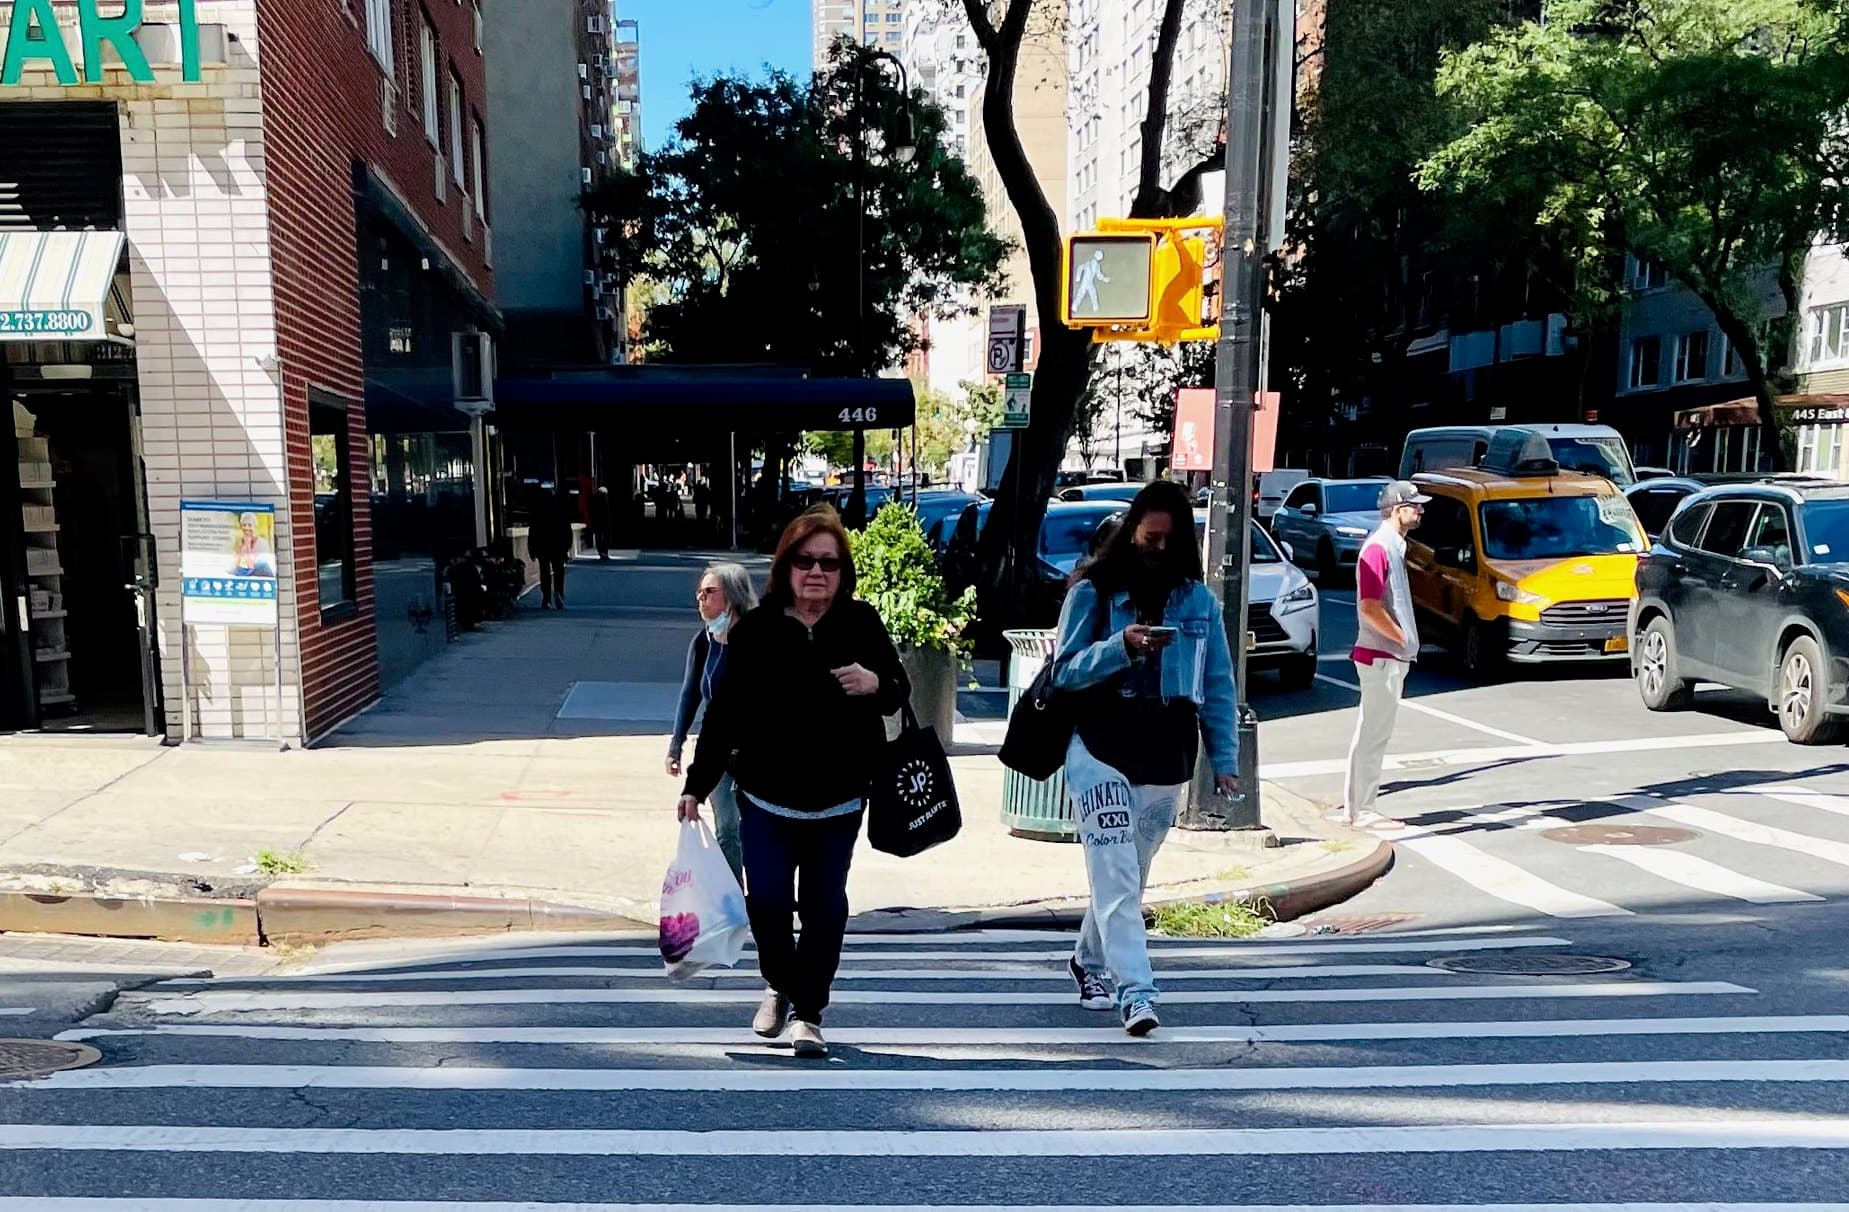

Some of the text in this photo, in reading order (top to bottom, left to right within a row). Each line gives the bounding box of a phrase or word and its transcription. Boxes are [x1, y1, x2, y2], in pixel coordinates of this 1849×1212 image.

[838, 407, 877, 423] 446
[1791, 408, 1816, 420] 445
[1817, 408, 1844, 420] East
[1100, 813, 1128, 828] XXL
